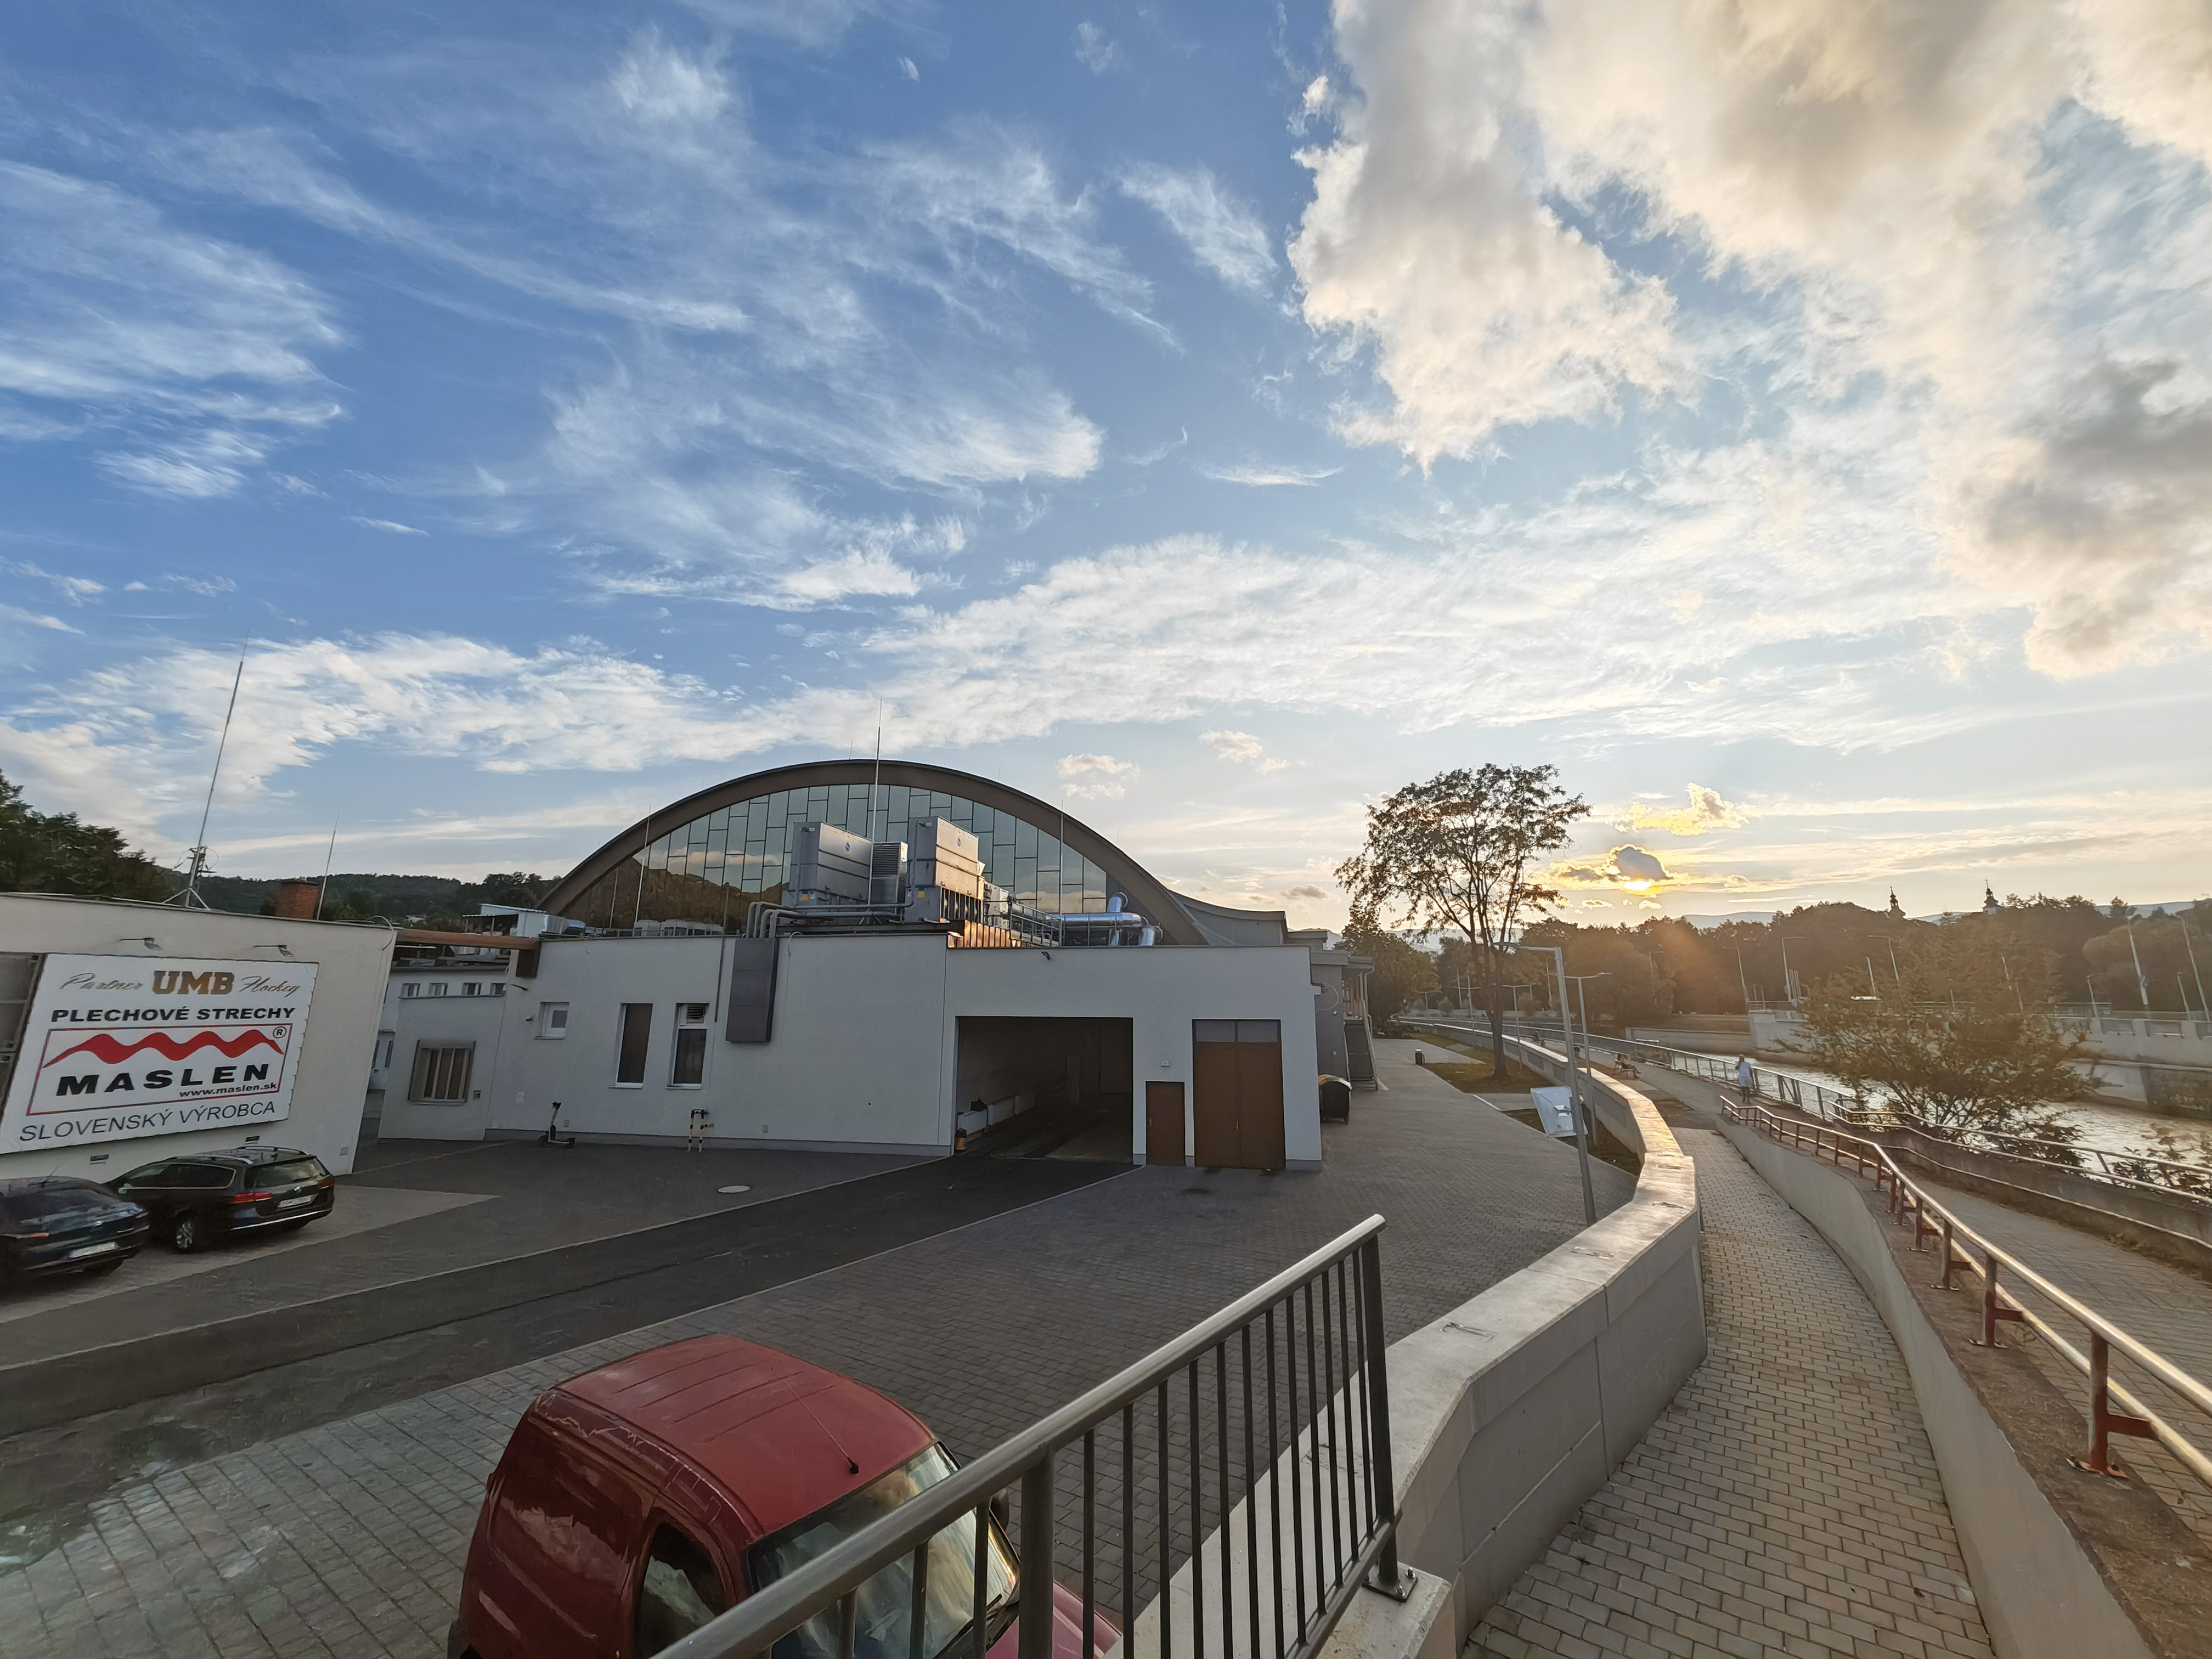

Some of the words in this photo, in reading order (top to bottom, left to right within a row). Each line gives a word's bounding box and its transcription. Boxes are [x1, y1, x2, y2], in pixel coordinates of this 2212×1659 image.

[153, 970, 235, 995] UMB
[239, 975, 301, 997] Hockey
[51, 1006, 190, 1022] PLECHOVÉ
[196, 1008, 296, 1020] STRECHY
[56, 1064, 269, 1096] MASLEN
[179, 1082, 277, 1097] www.maslen.sk
[20, 1108, 173, 1142] SLOVENSKÝ
[180, 1101, 275, 1124] VÝROBCA
